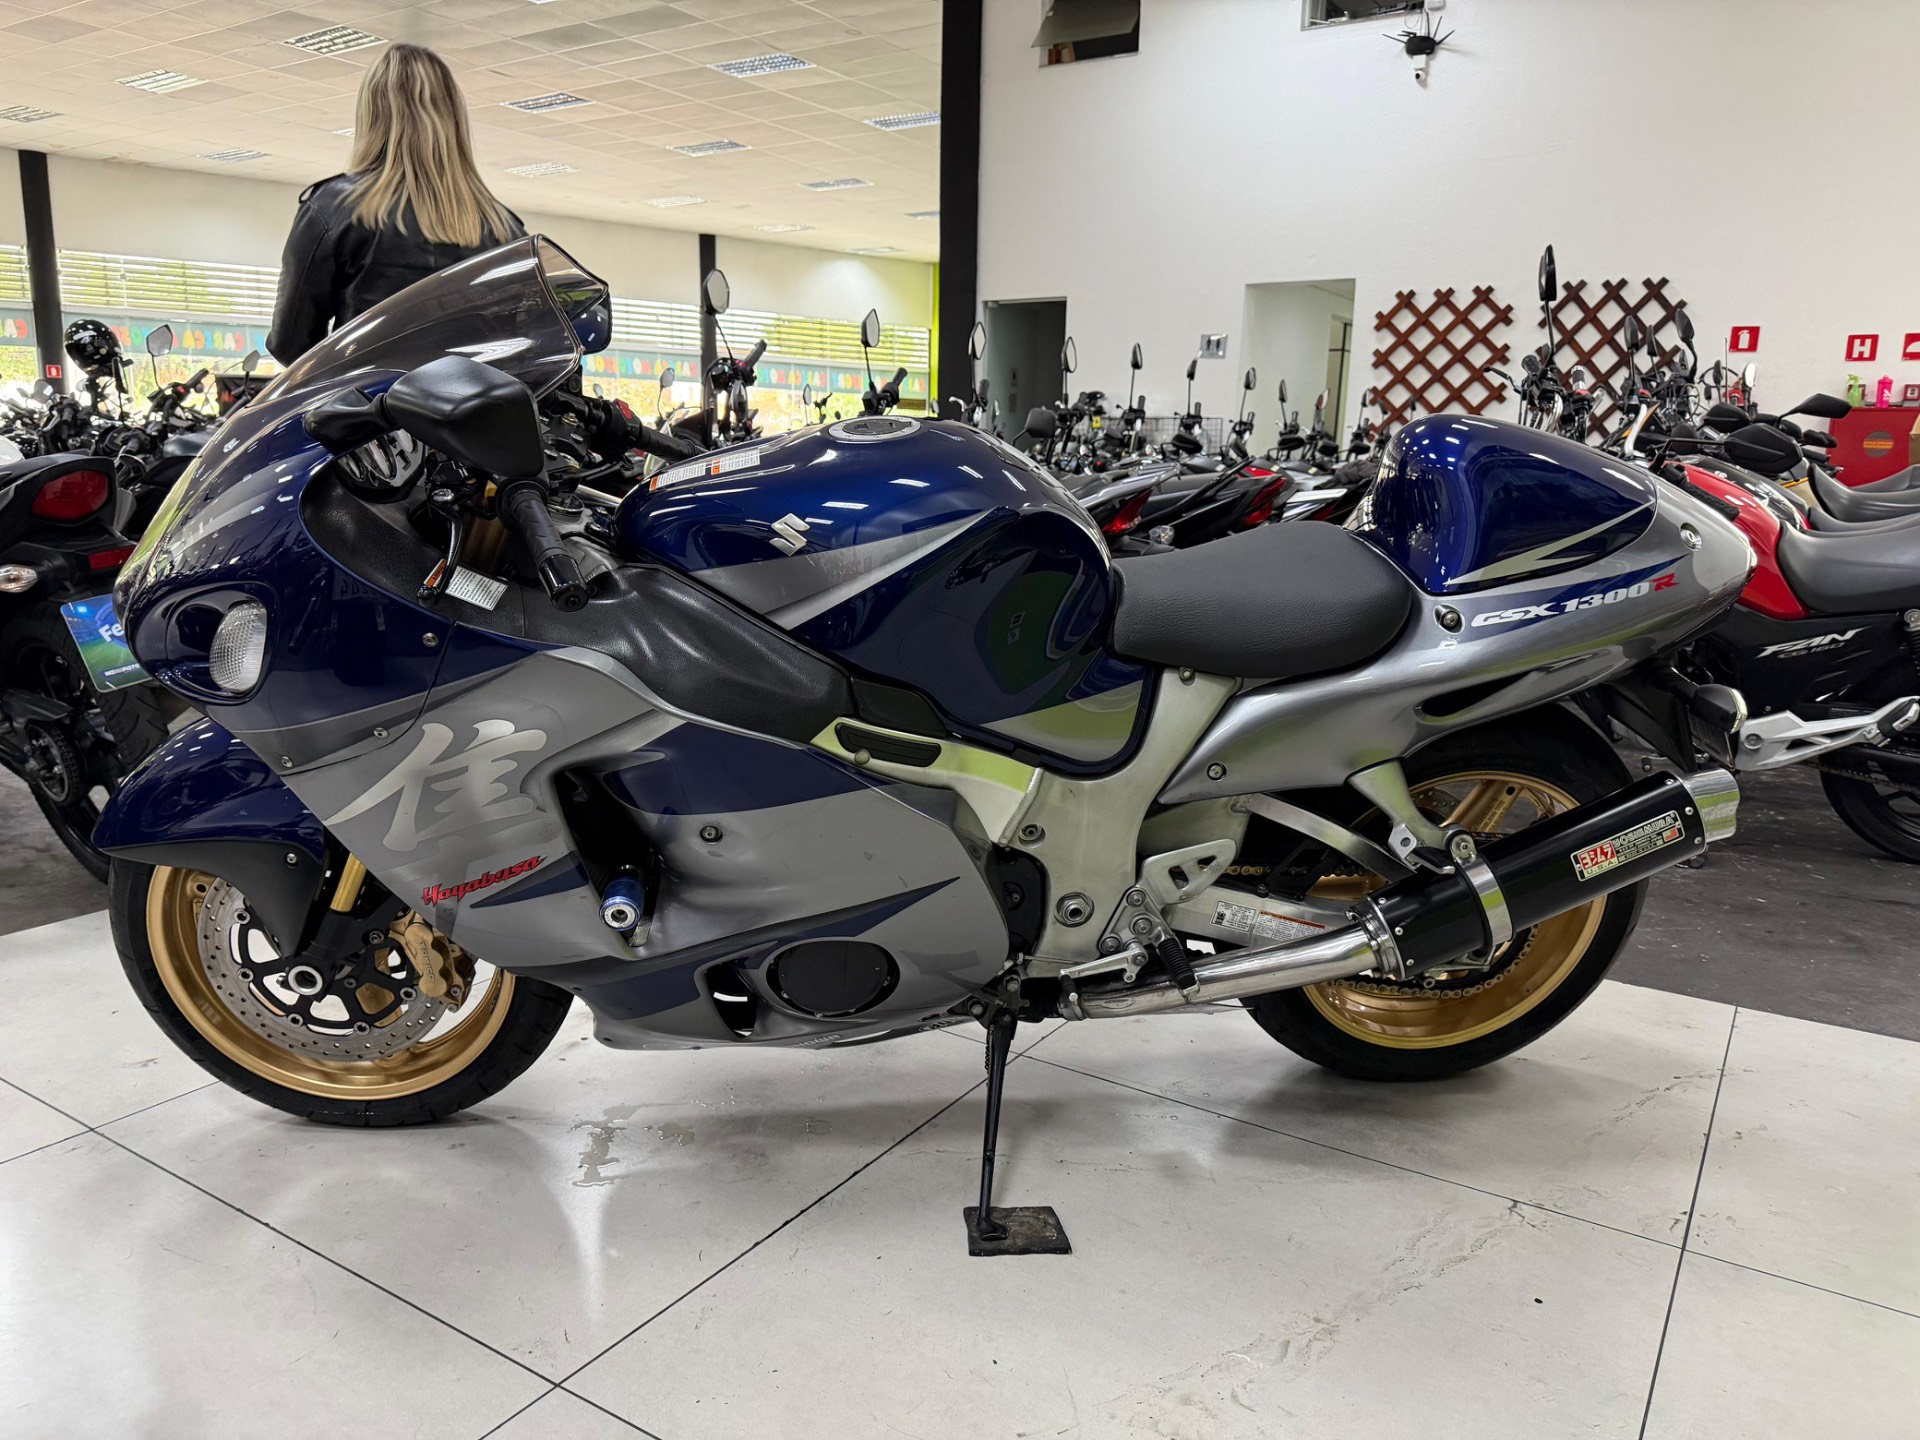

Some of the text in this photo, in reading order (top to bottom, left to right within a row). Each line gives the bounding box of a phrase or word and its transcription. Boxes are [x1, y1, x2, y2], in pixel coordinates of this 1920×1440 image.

[98, 623, 125, 642] Fe
[1753, 626, 1872, 659] FAN
[421, 855, 547, 907] Hayabusa
